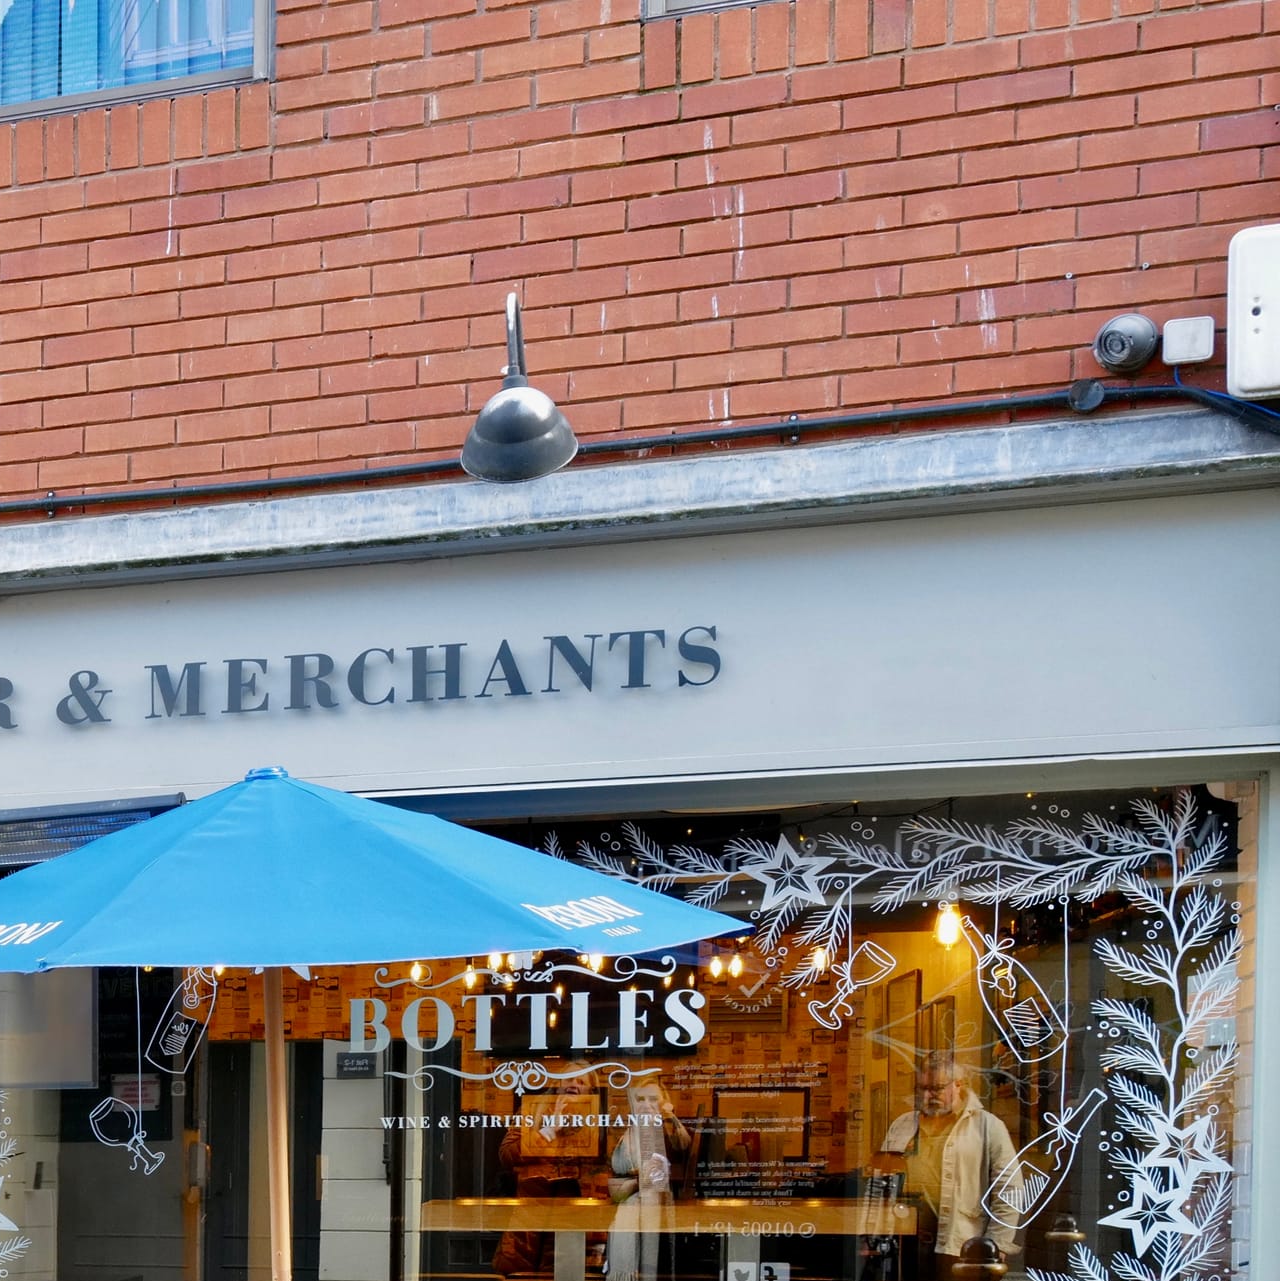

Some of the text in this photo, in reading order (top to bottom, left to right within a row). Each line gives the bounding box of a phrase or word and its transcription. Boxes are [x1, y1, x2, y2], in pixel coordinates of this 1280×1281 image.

[55, 669, 111, 726] &
[144, 625, 722, 719] MERCHANTS
[520, 896, 644, 930] PERONI
[348, 989, 706, 1054] BOTTLES
[380, 1114, 663, 1130] WINE & SPIRITS MERCHANTS
